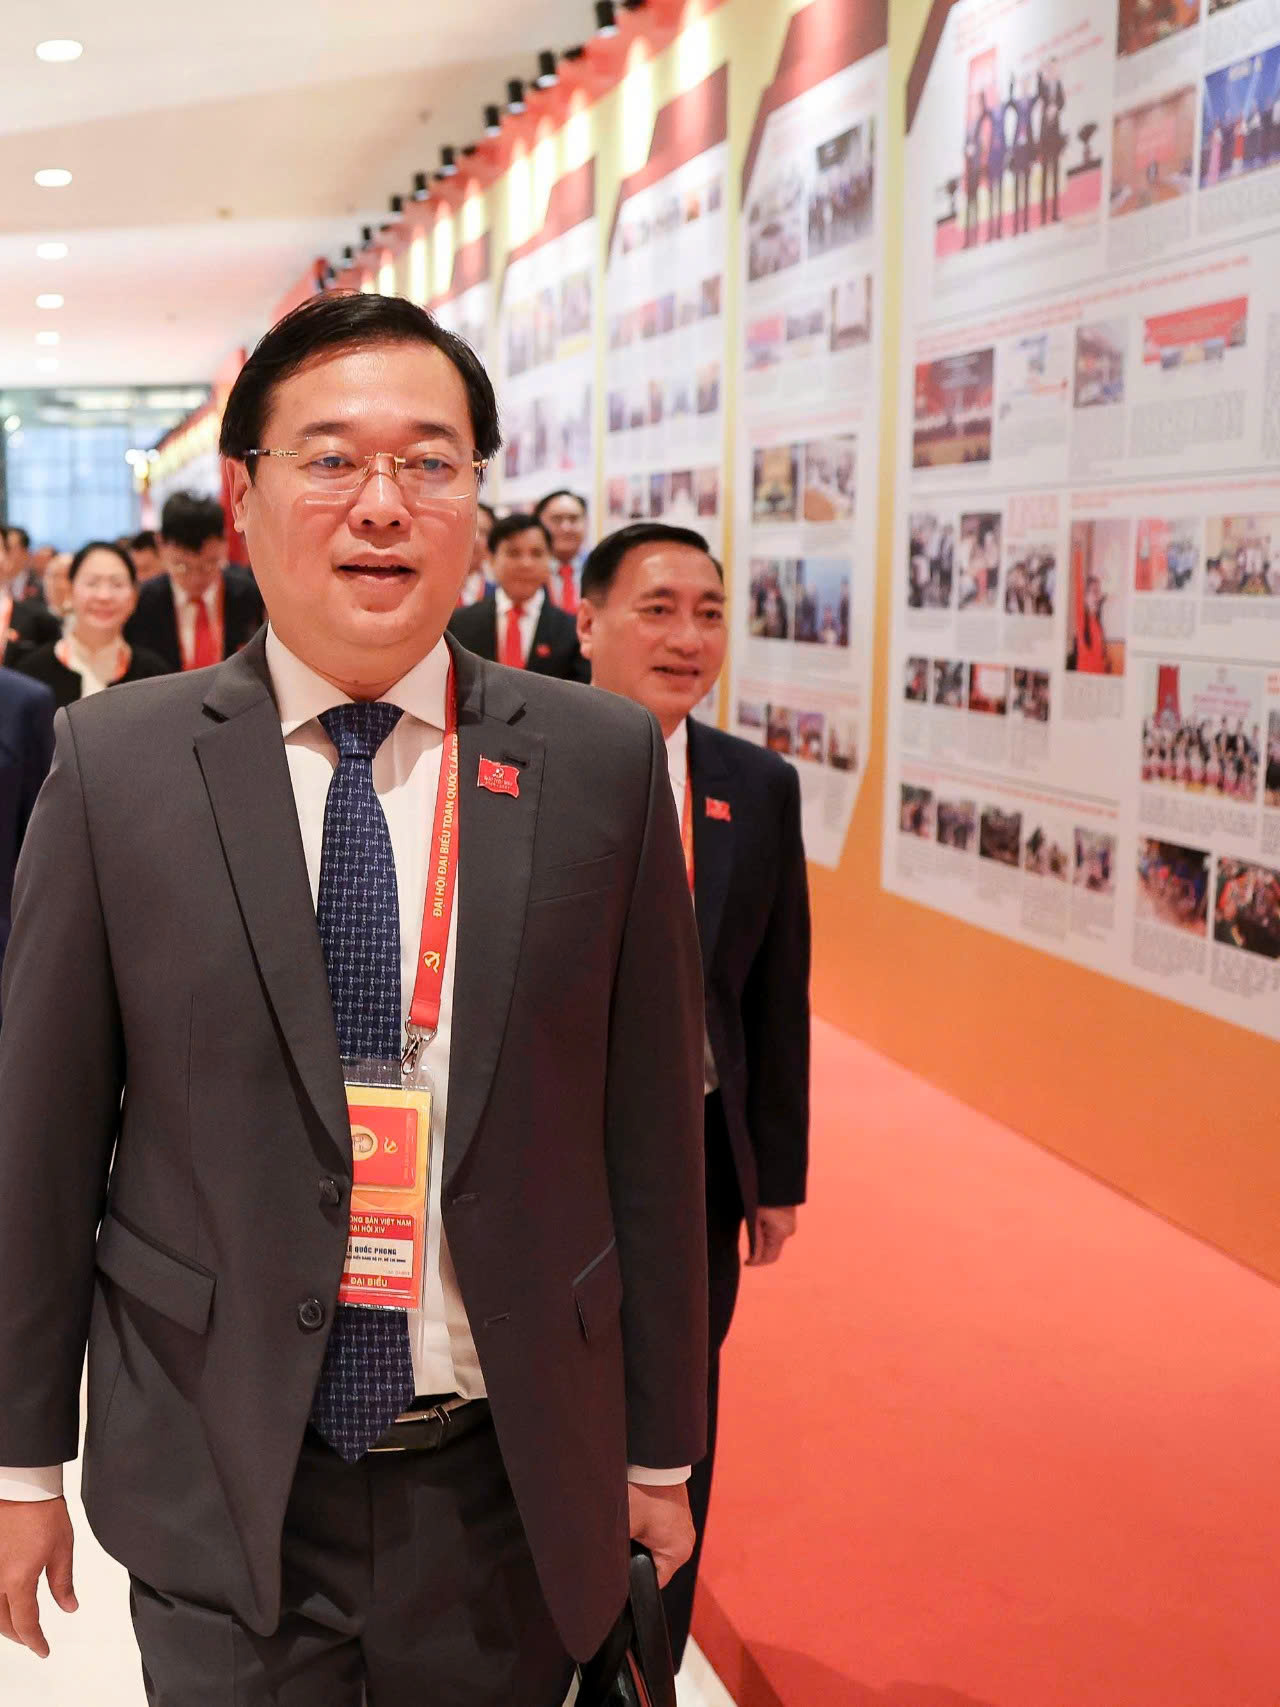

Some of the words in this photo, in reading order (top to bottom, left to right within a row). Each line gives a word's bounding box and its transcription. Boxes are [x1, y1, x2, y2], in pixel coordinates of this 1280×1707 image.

[443, 800, 455, 829] TOÀN
[437, 856, 450, 875] ĐẠI
[435, 876, 448, 896] HỘI
[432, 896, 445, 917] ĐẠI
[375, 1226, 385, 1234] XIV
[397, 1219, 411, 1227] NAM
[355, 1245, 372, 1253] QUỐC
[351, 1276, 365, 1286] ĐẠI
